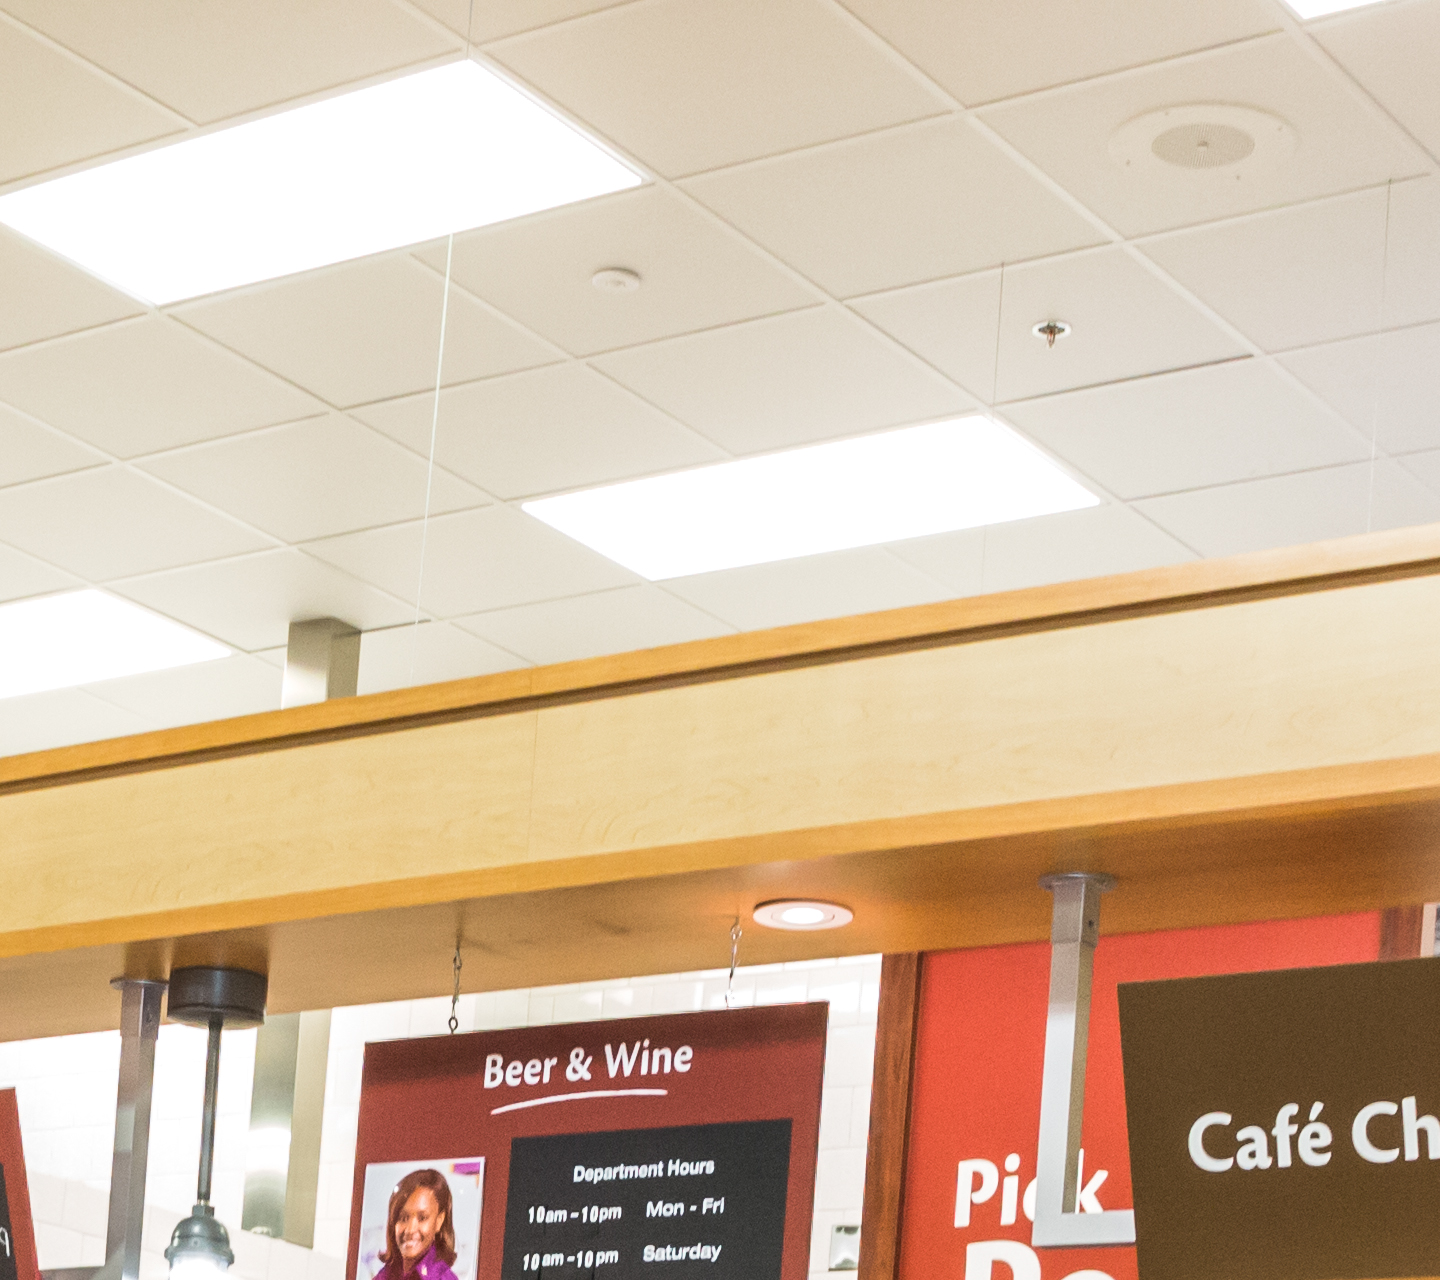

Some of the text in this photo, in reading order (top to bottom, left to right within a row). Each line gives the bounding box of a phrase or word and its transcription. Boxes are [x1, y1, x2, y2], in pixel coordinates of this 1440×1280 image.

[483, 1039, 694, 1090] Beer & Wine
[1187, 1101, 1334, 1174] Café
[573, 1158, 715, 1185] Department Hours
[954, 1148, 1108, 1228] Pik
[646, 1201, 685, 1218] Mon
[702, 1197, 725, 1215] Fri
[643, 1244, 722, 1264] Saturday
